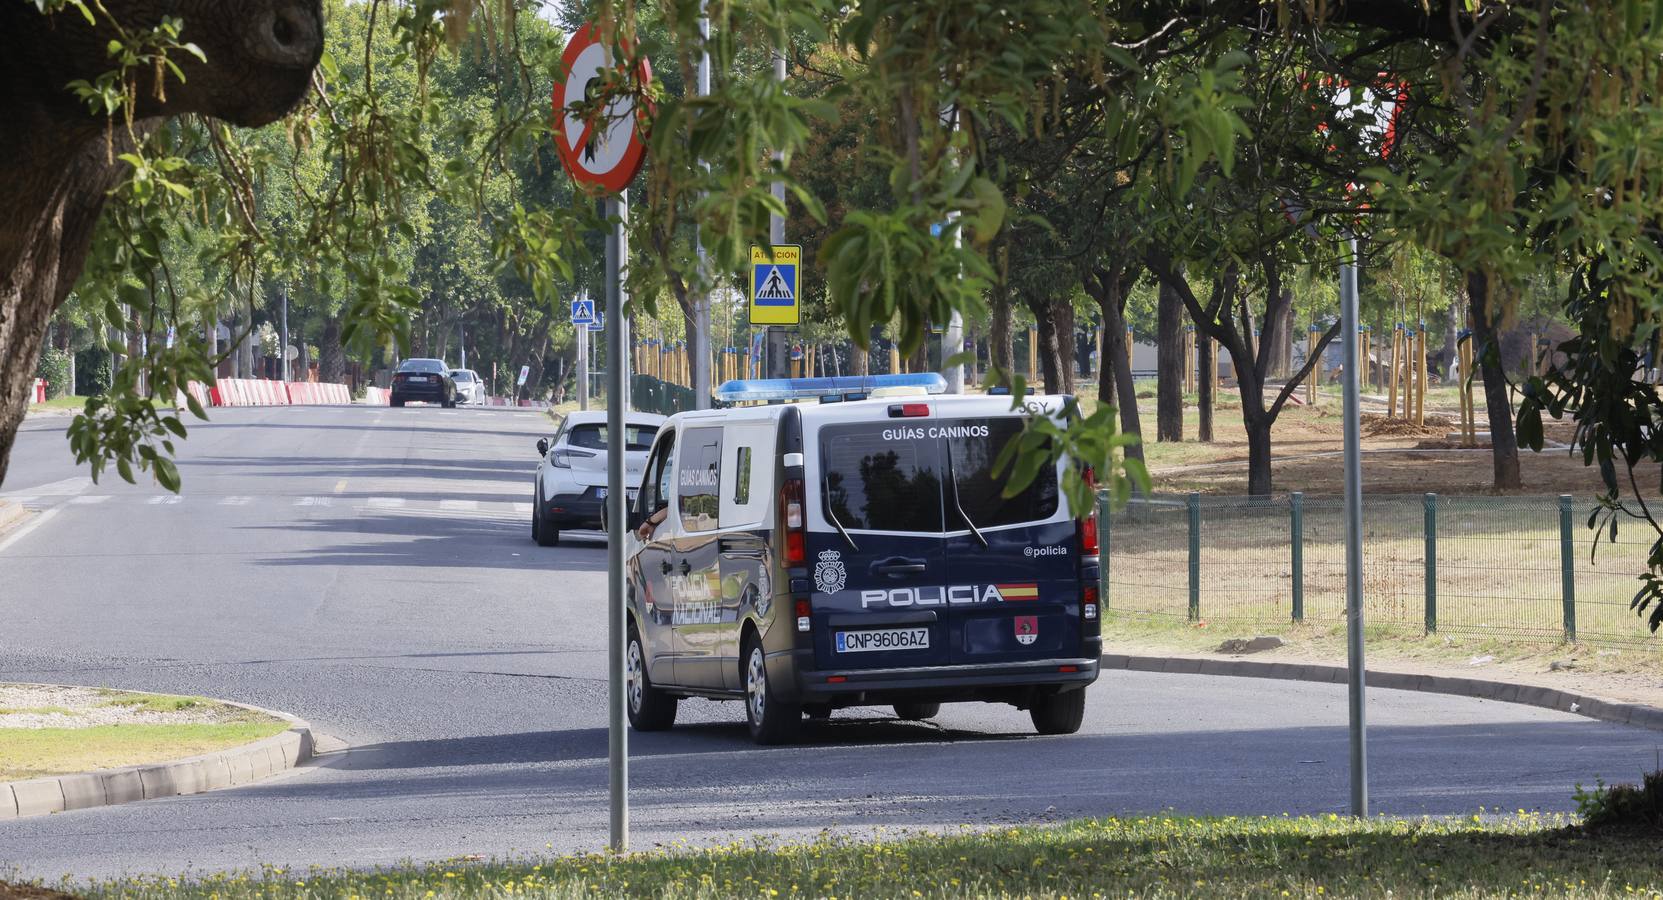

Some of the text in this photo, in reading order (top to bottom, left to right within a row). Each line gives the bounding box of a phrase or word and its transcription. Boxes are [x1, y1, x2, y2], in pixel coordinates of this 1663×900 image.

[754, 251, 797, 259] ATCION
[882, 425, 989, 441] GUÍAS CANINOS
[1023, 545, 1067, 558] @policia
[846, 630, 928, 650] CNP9606AZ
